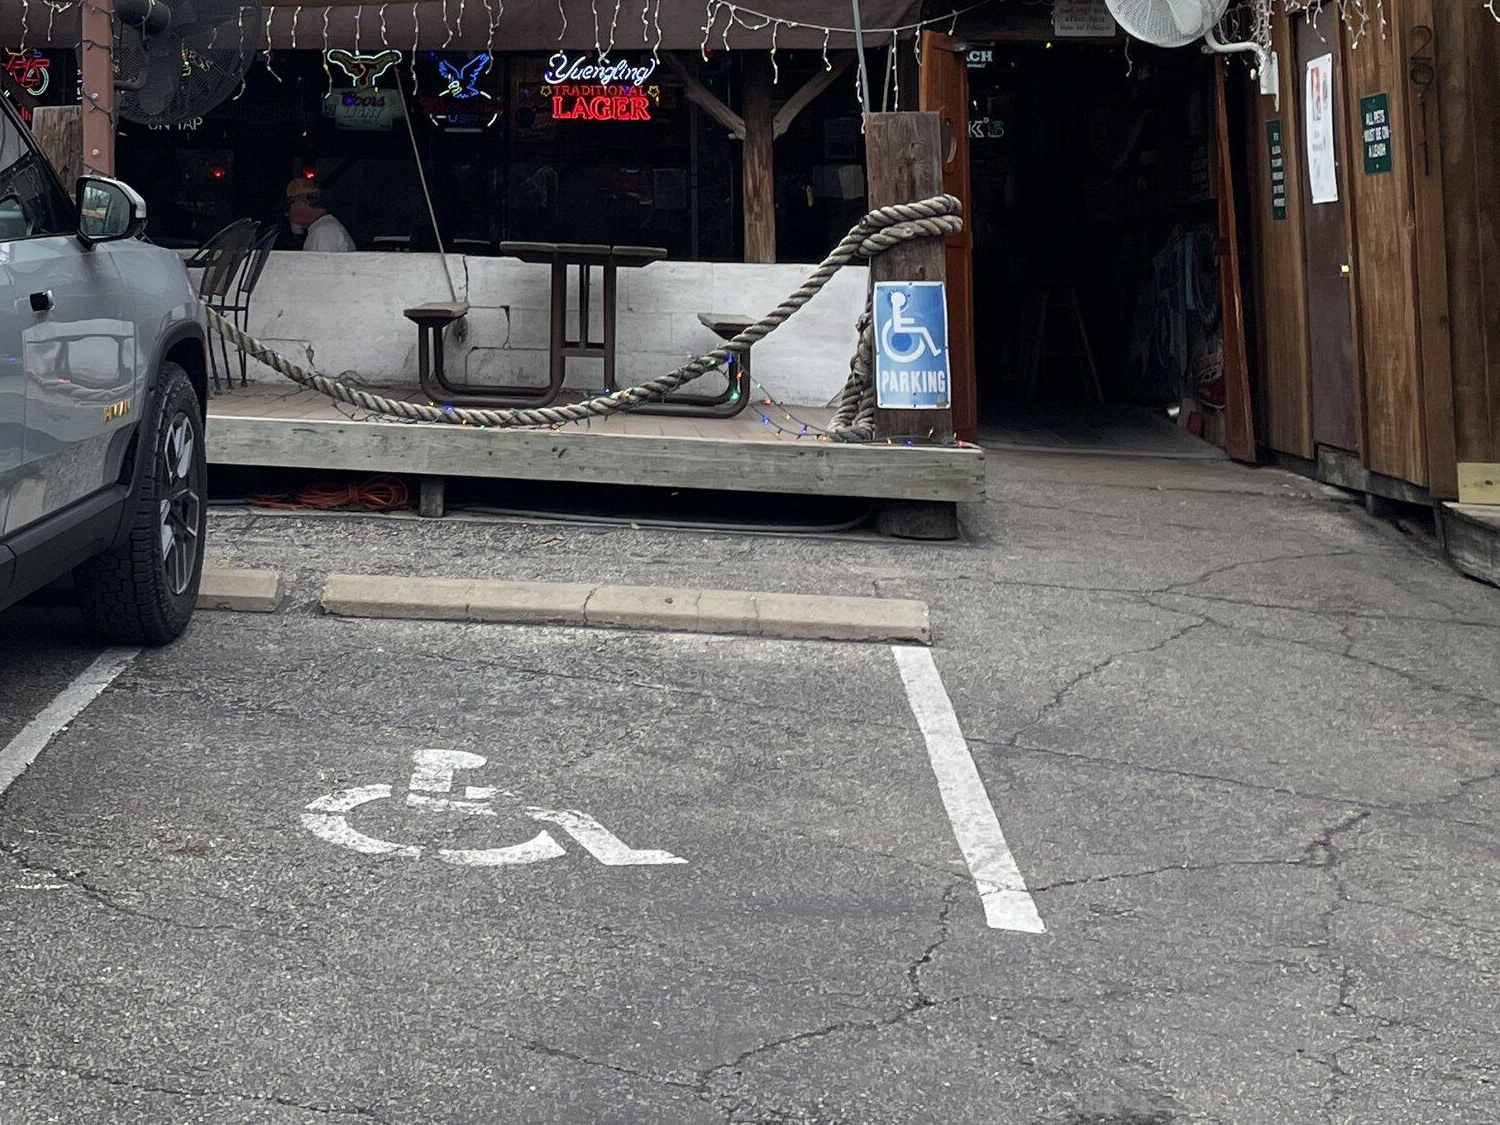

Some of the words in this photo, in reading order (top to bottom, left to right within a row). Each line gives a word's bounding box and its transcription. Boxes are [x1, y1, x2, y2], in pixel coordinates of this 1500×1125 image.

[544, 53, 656, 86] Yuengling
[553, 85, 647, 96] TRADITIONAL
[552, 96, 651, 121] LAGER
[881, 370, 946, 393] PARKING
